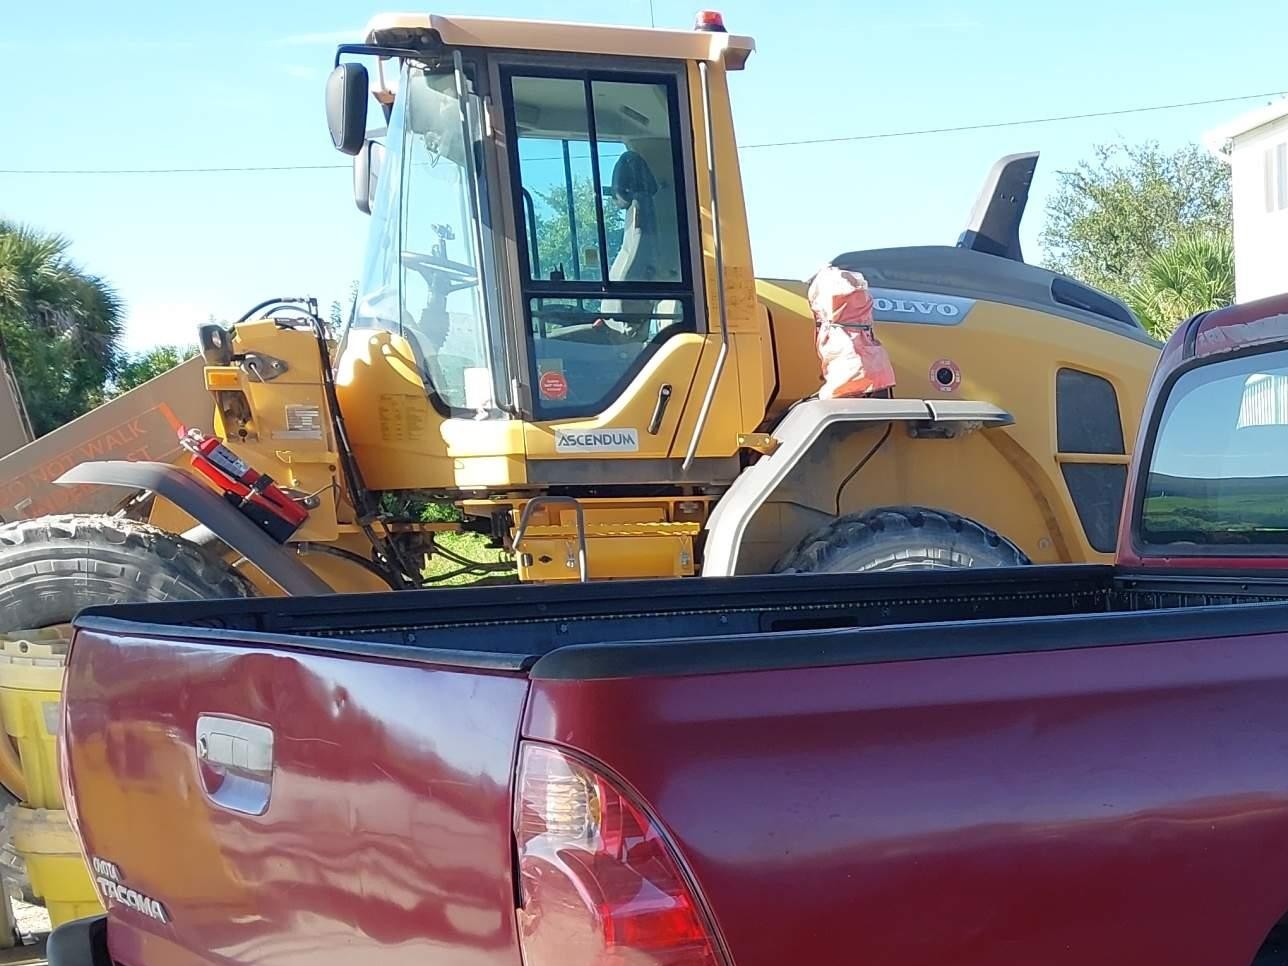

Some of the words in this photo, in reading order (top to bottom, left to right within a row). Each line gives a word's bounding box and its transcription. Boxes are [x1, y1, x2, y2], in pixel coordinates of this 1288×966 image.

[872, 298, 959, 316] OLVO
[85, 420, 146, 457] WALK
[558, 433, 635, 447] ASCENDUM
[96, 876, 167, 924] TACOMA
